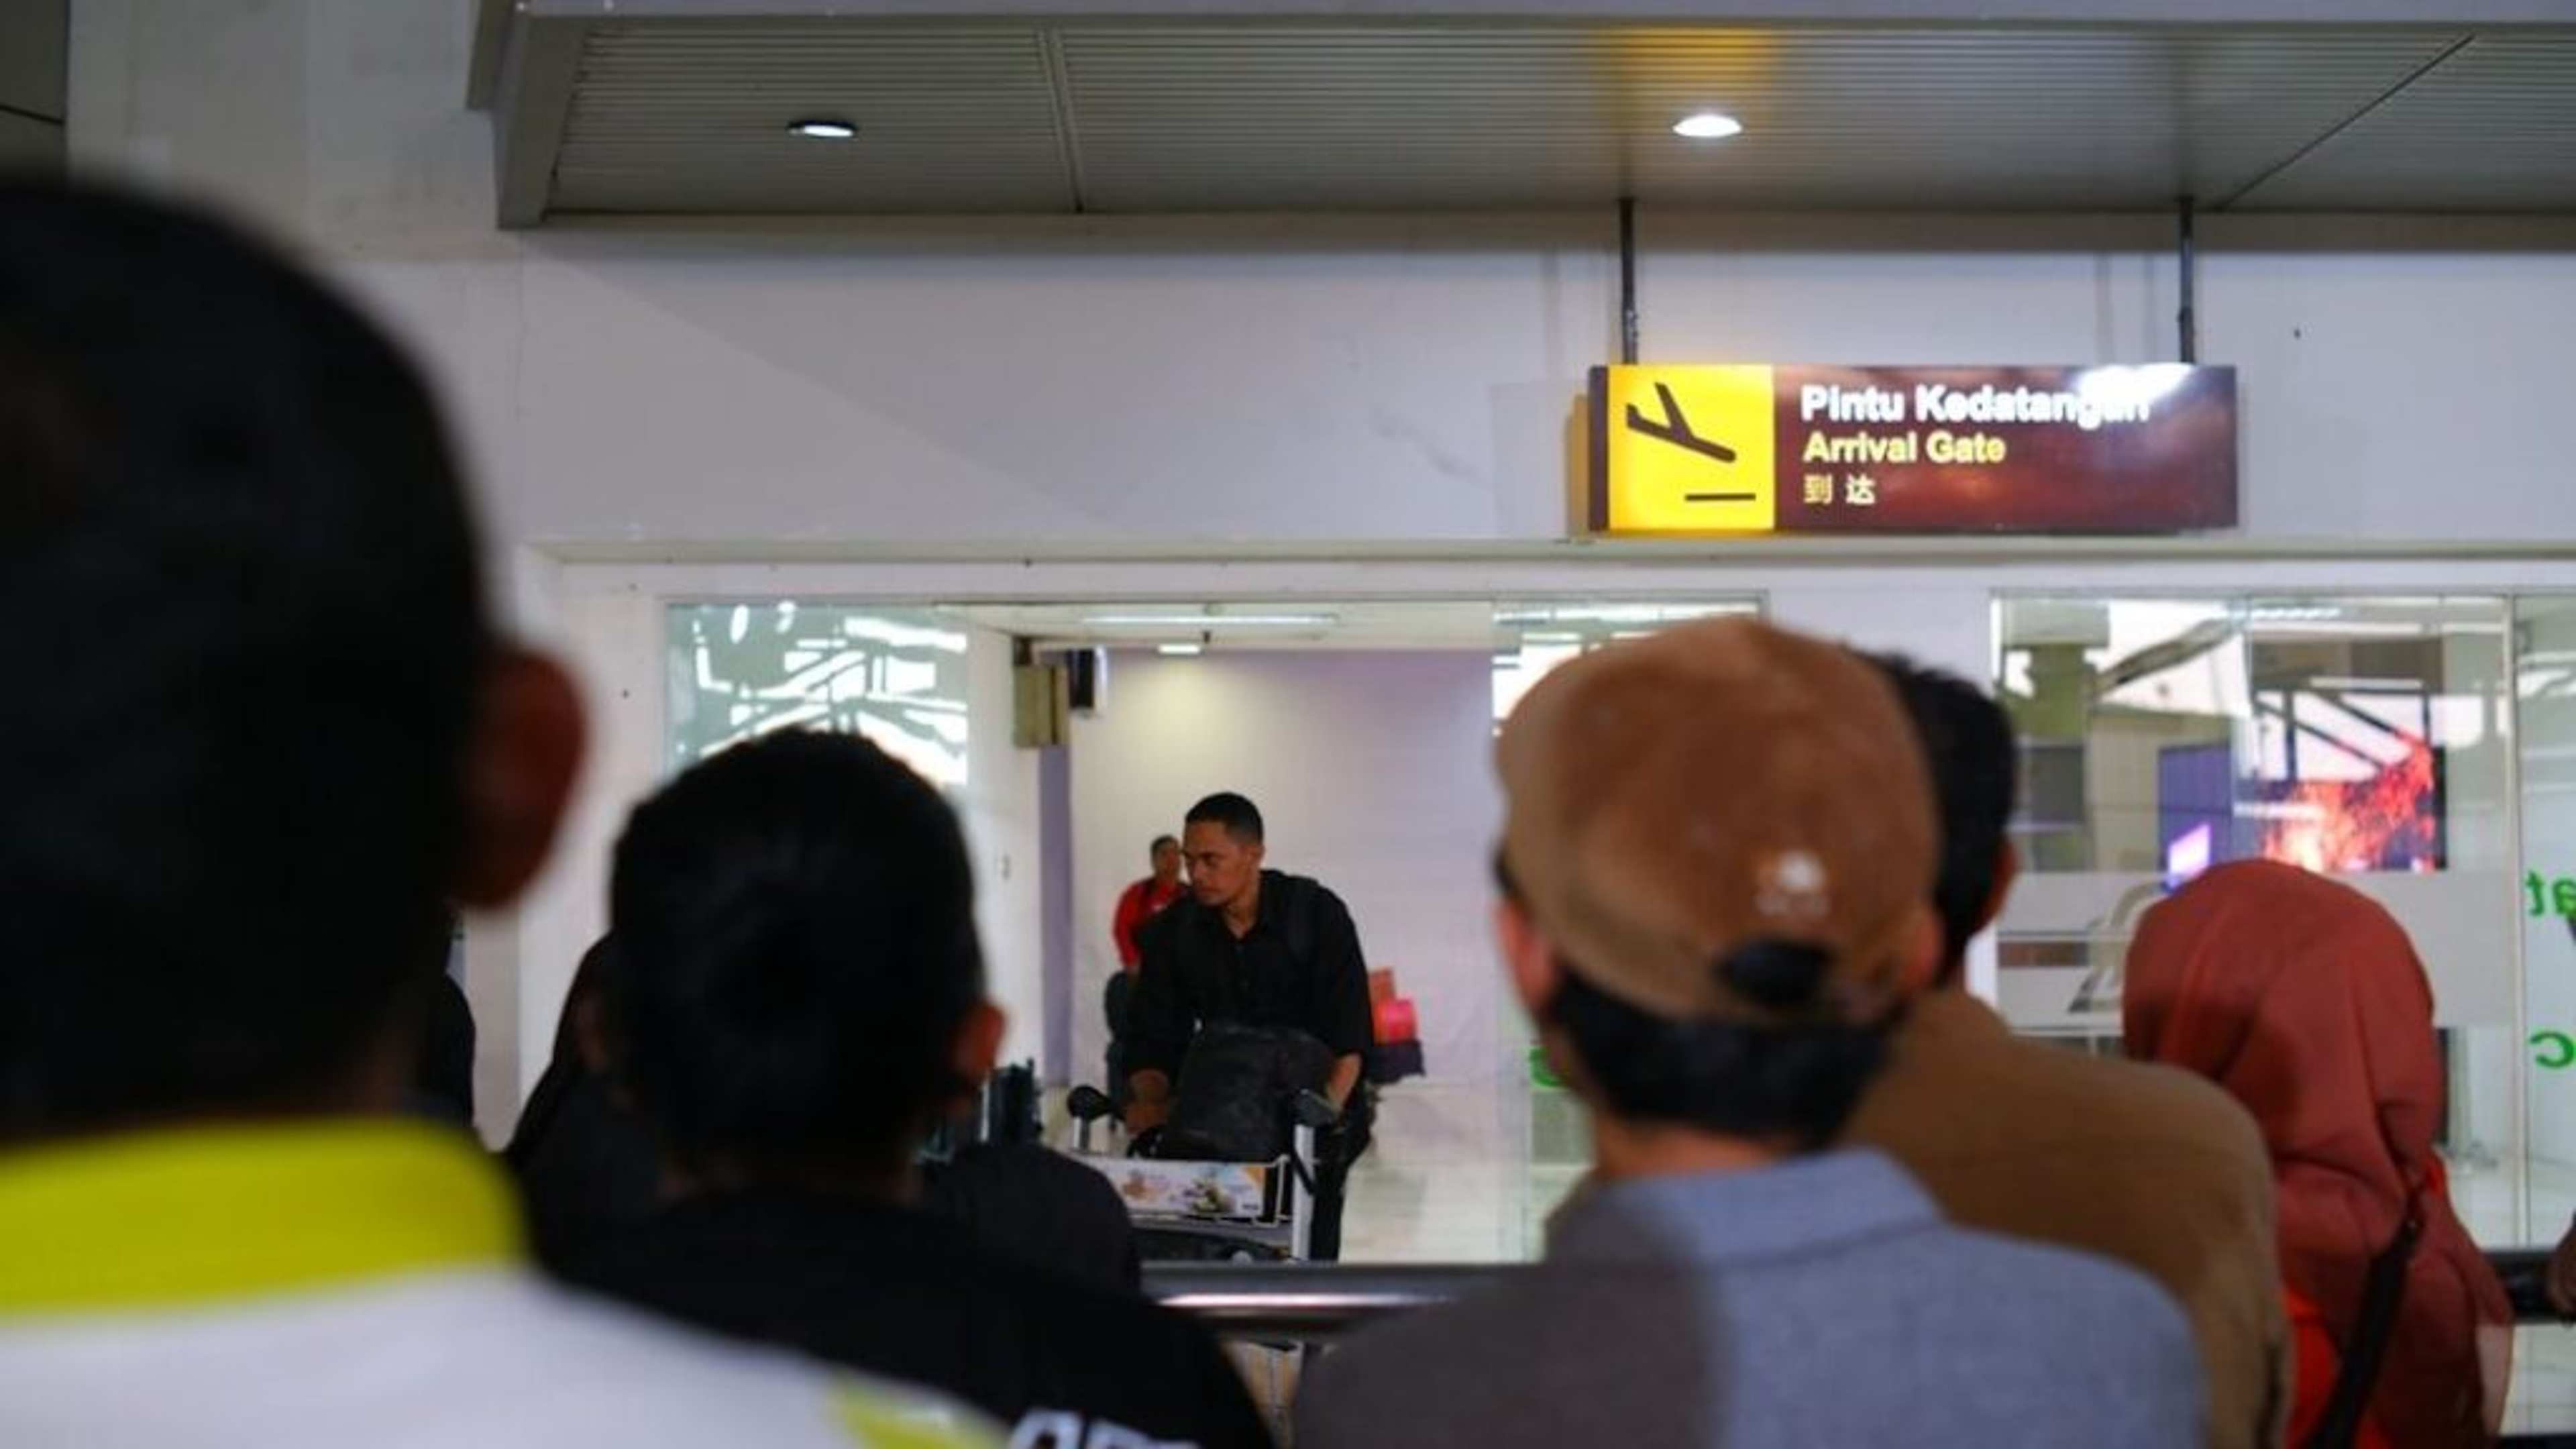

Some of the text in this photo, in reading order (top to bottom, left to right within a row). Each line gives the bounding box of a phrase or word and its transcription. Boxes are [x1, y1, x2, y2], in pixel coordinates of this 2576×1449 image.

[1801, 384, 1904, 422] Pintu
[1803, 430, 2006, 464] Arrival Gate
[1804, 474, 1876, 504] 到达
